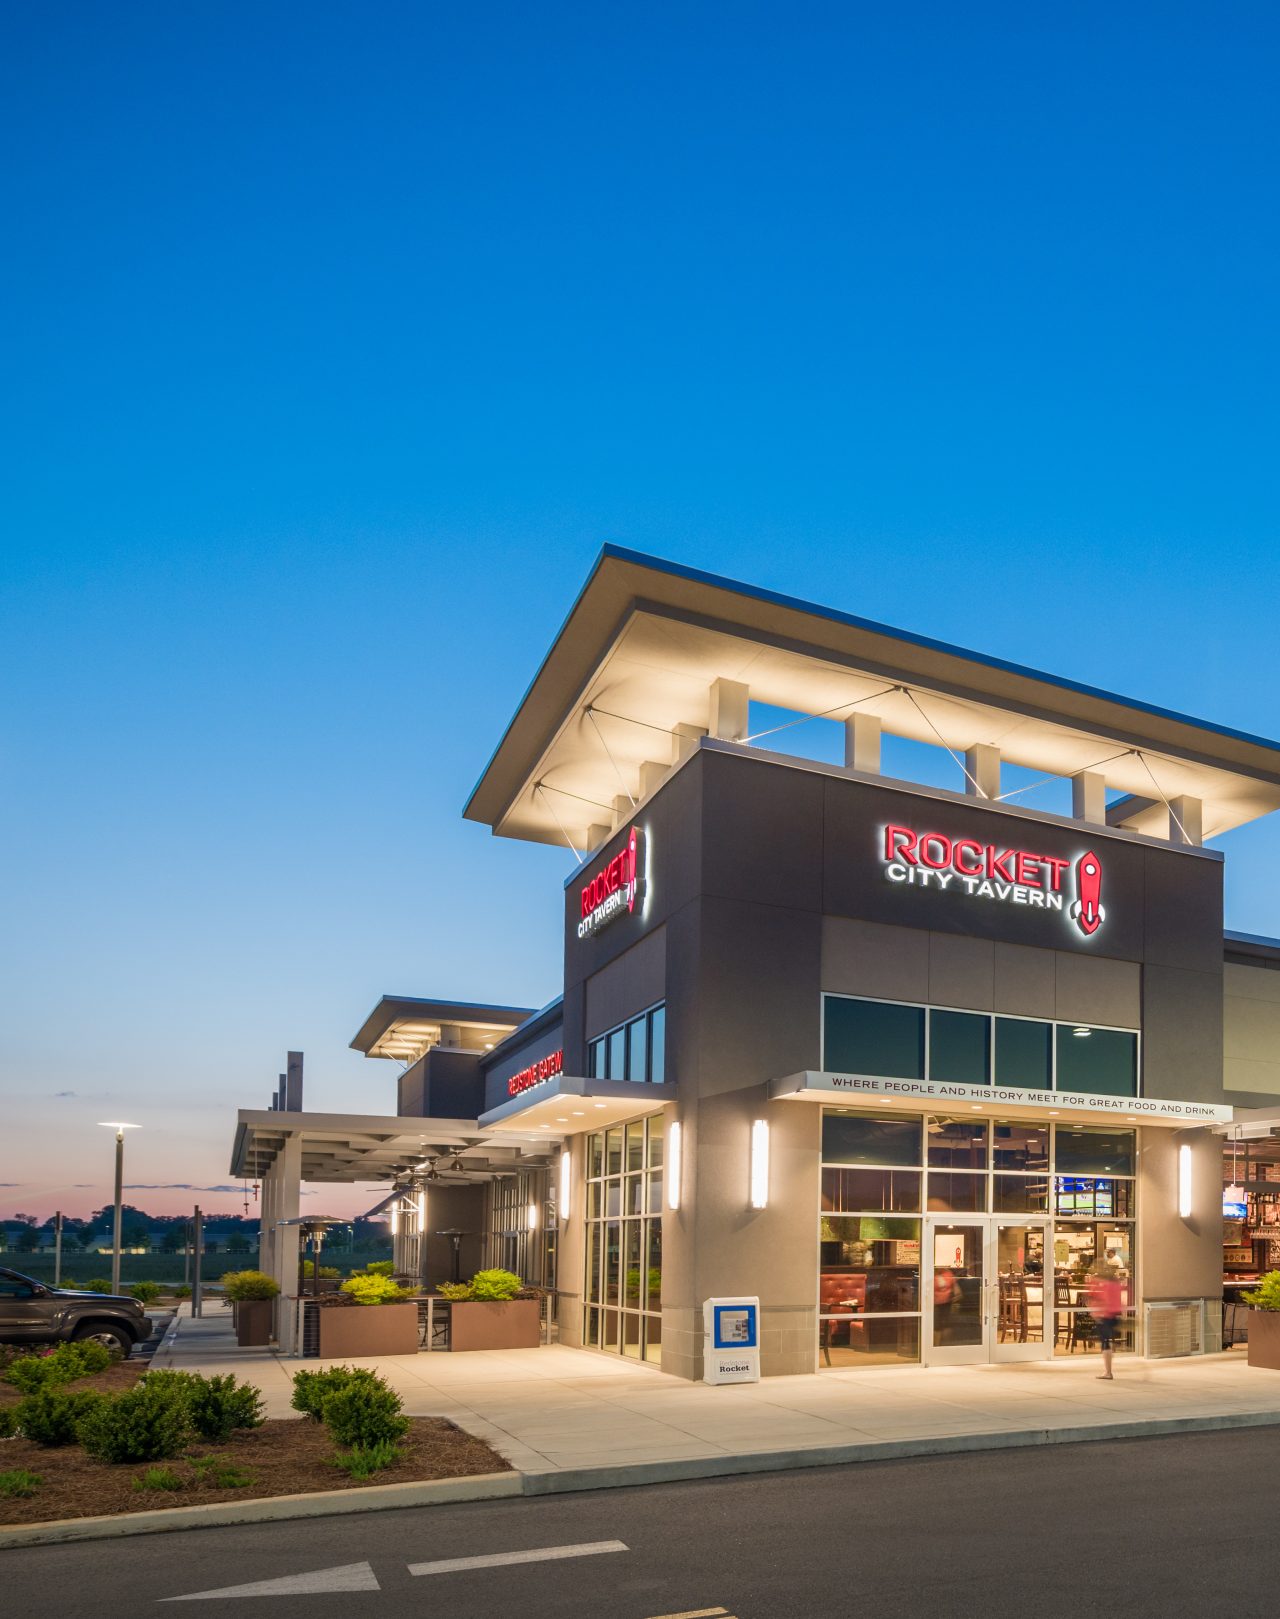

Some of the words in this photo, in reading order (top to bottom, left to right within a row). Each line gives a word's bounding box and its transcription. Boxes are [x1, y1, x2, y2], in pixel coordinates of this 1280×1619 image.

[885, 824, 1070, 891] ROCKET
[581, 849, 627, 919] ROCKET
[887, 864, 953, 889] CITY
[962, 877, 1063, 910] TAVERN
[577, 912, 593, 938] CITY
[593, 889, 620, 923] TAVERN
[508, 1064, 537, 1096] REDSTONE
[540, 1049, 563, 1080] GATEW
[832, 1078, 879, 1089] WHERE
[884, 1082, 935, 1094] PEOPLE
[939, 1086, 966, 1096] AND
[971, 1089, 1023, 1100] HISTORY
[1027, 1093, 1058, 1103] MEET
[1063, 1096, 1084, 1105] FOR
[1089, 1098, 1125, 1109] GREAT
[1128, 1101, 1157, 1111] FOOD
[1160, 1104, 1182, 1113] AND
[1185, 1106, 1215, 1116] DRINK
